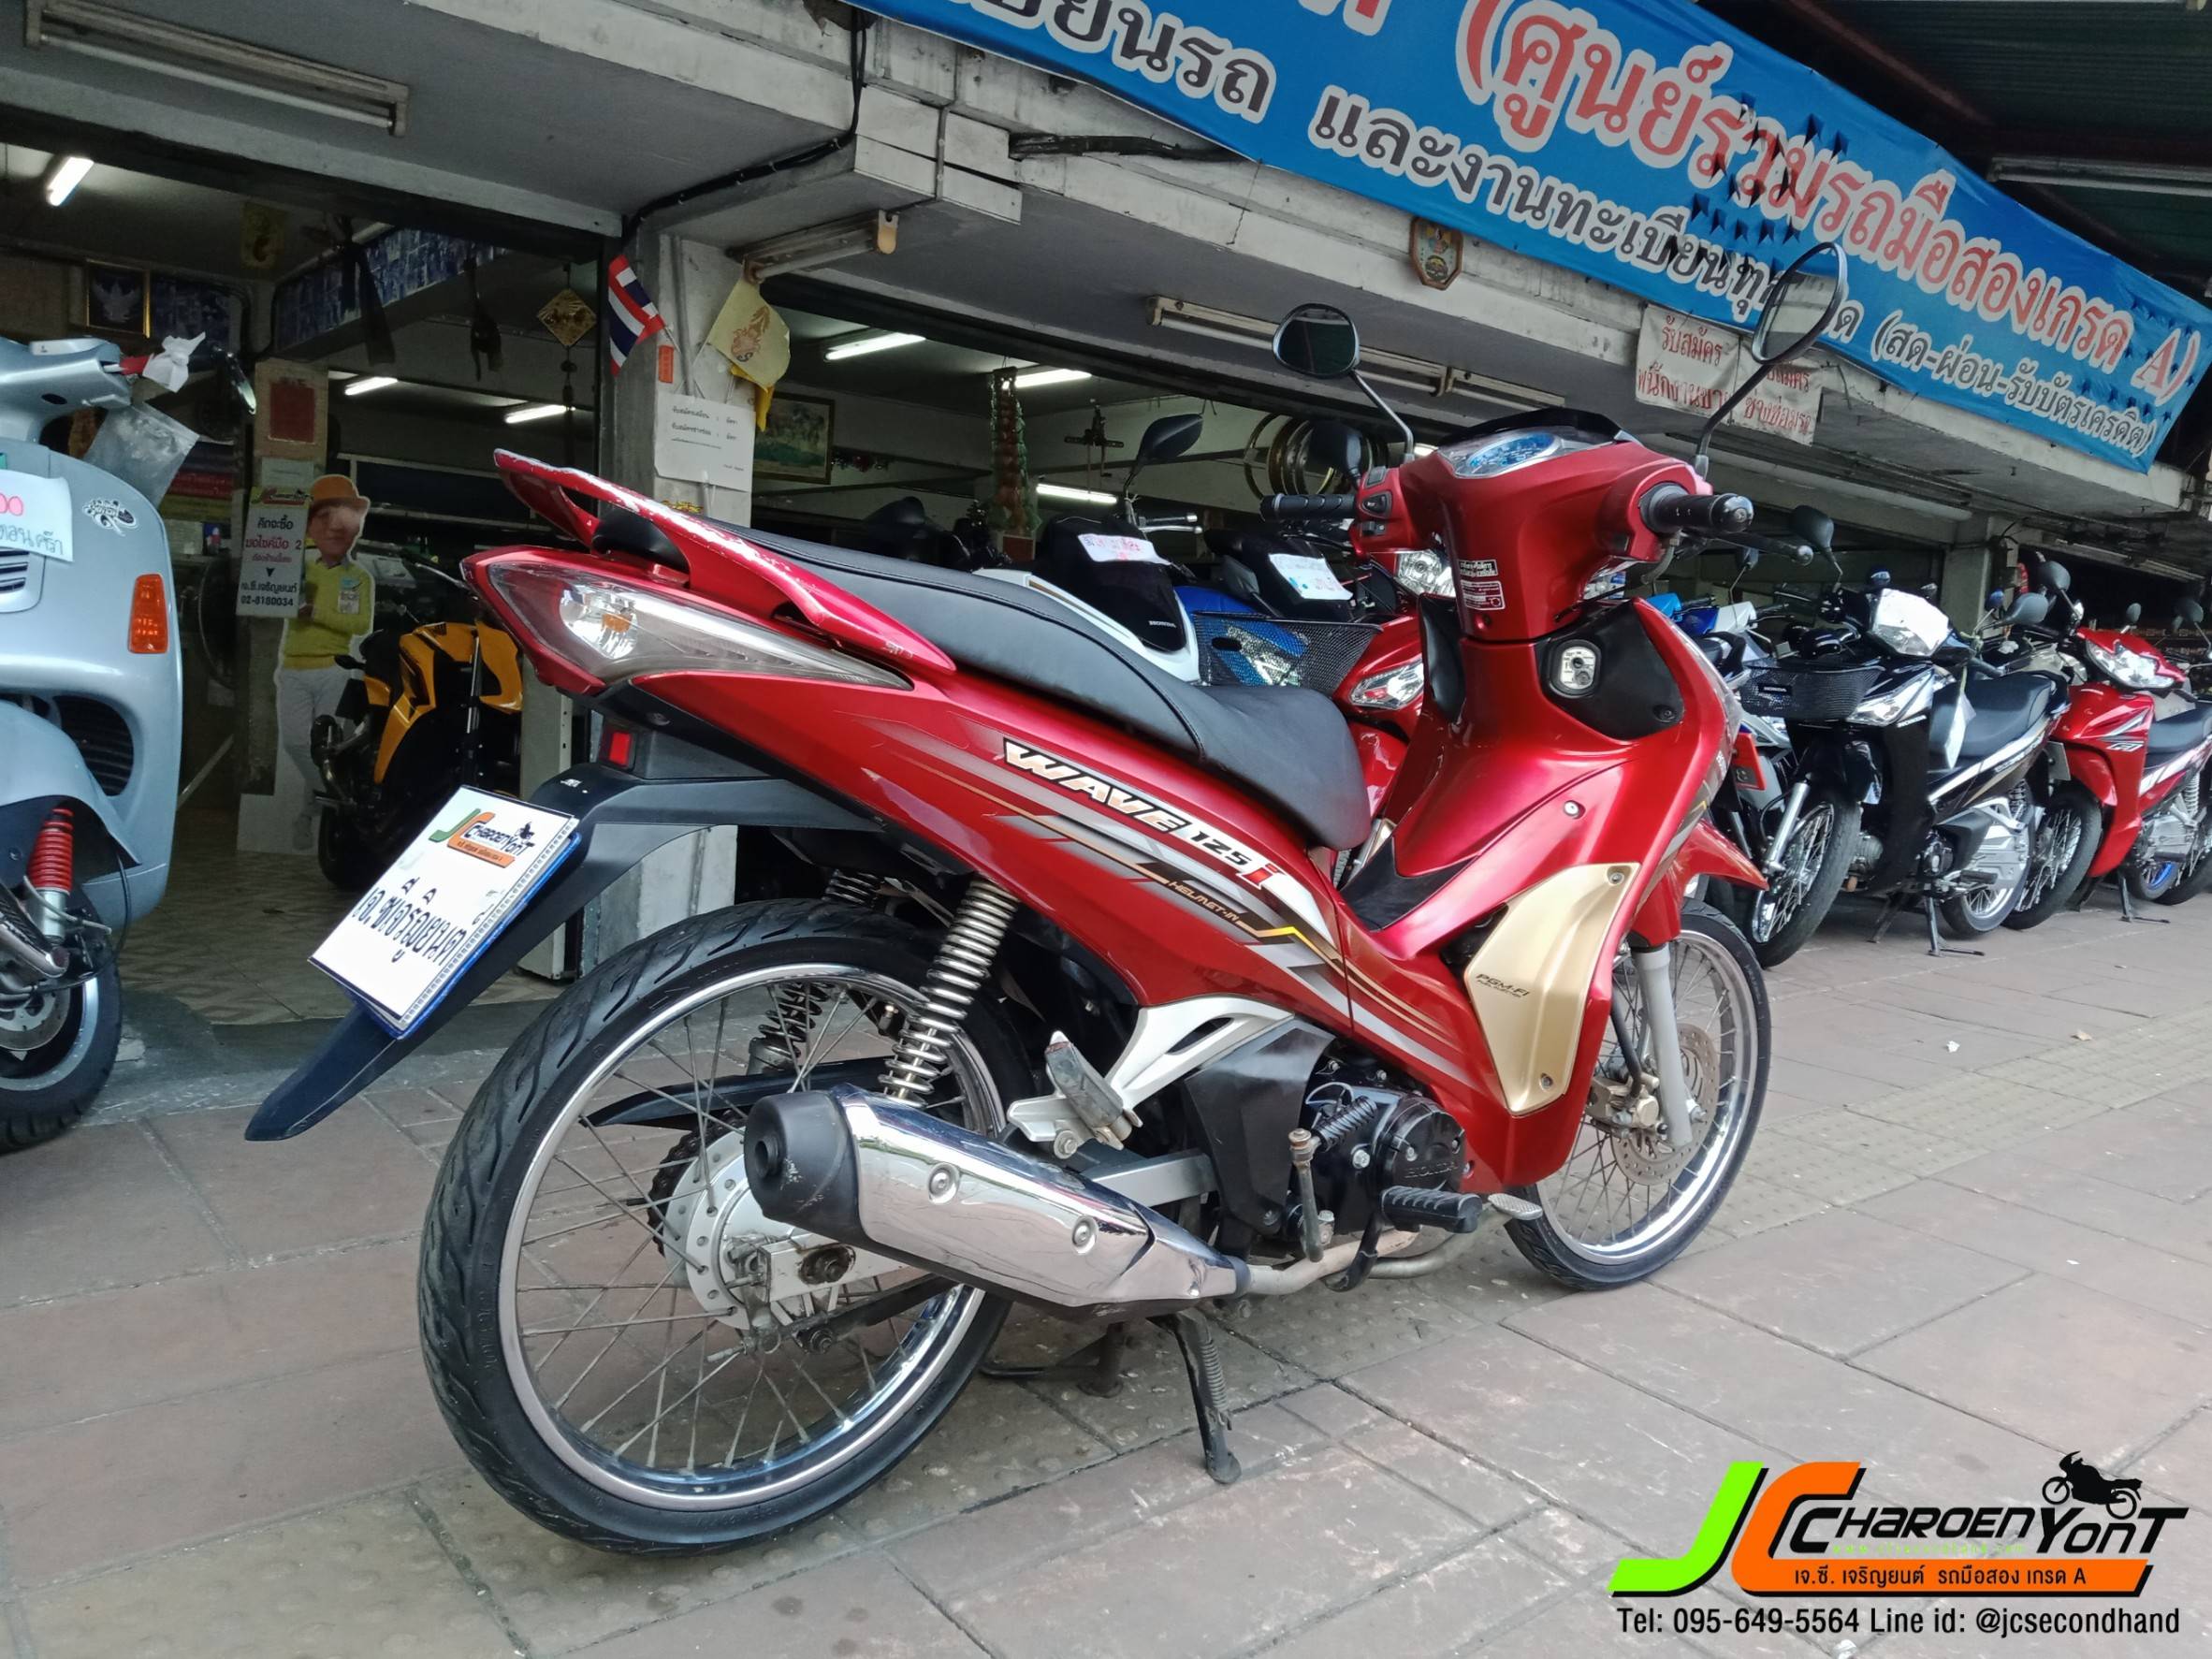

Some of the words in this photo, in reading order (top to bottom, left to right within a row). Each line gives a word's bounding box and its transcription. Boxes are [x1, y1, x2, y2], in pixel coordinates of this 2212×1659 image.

[1662, 316, 1723, 366] รับสมัคร
[2140, 334, 2197, 399] A)
[296, 540, 302, 550] 2
[1004, 737, 1191, 834] WAVE
[1168, 880, 1240, 923] HELMET-IN
